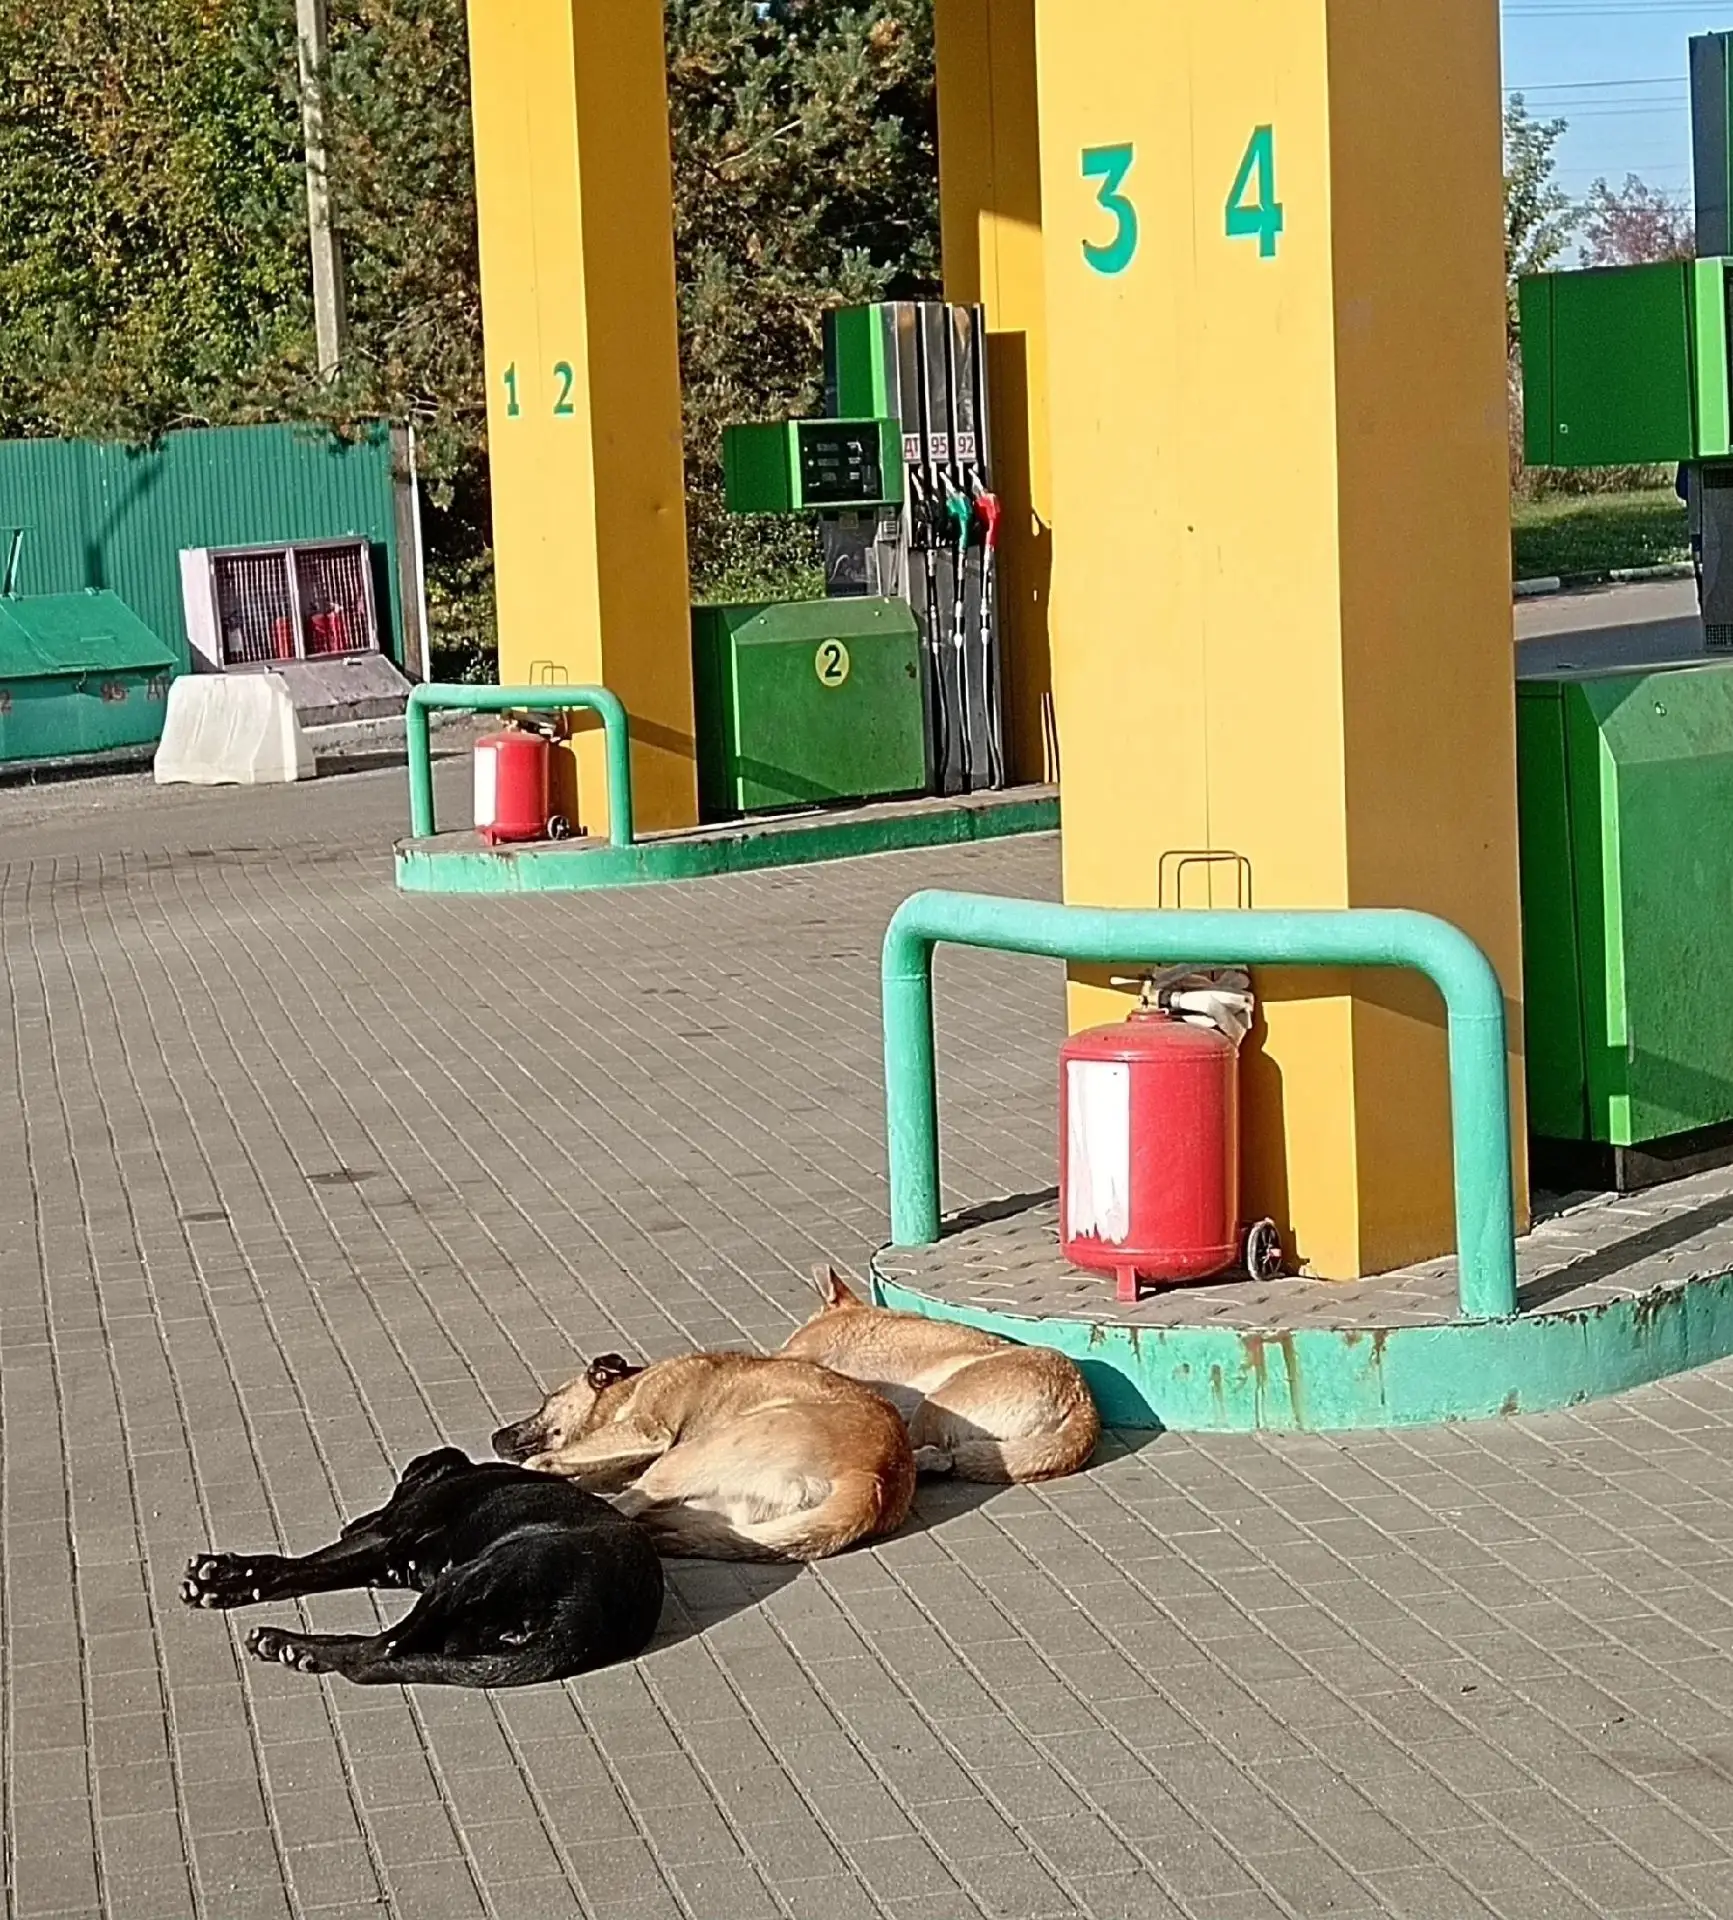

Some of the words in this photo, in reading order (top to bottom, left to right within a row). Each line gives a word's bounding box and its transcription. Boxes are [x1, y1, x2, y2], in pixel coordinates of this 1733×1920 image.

[1081, 142, 1138, 273] 3
[1225, 124, 1283, 257] 4
[504, 361, 519, 416] 1
[553, 361, 574, 414] 2
[931, 436, 947, 454] 95
[958, 436, 974, 454] 92
[824, 644, 842, 678] 2
